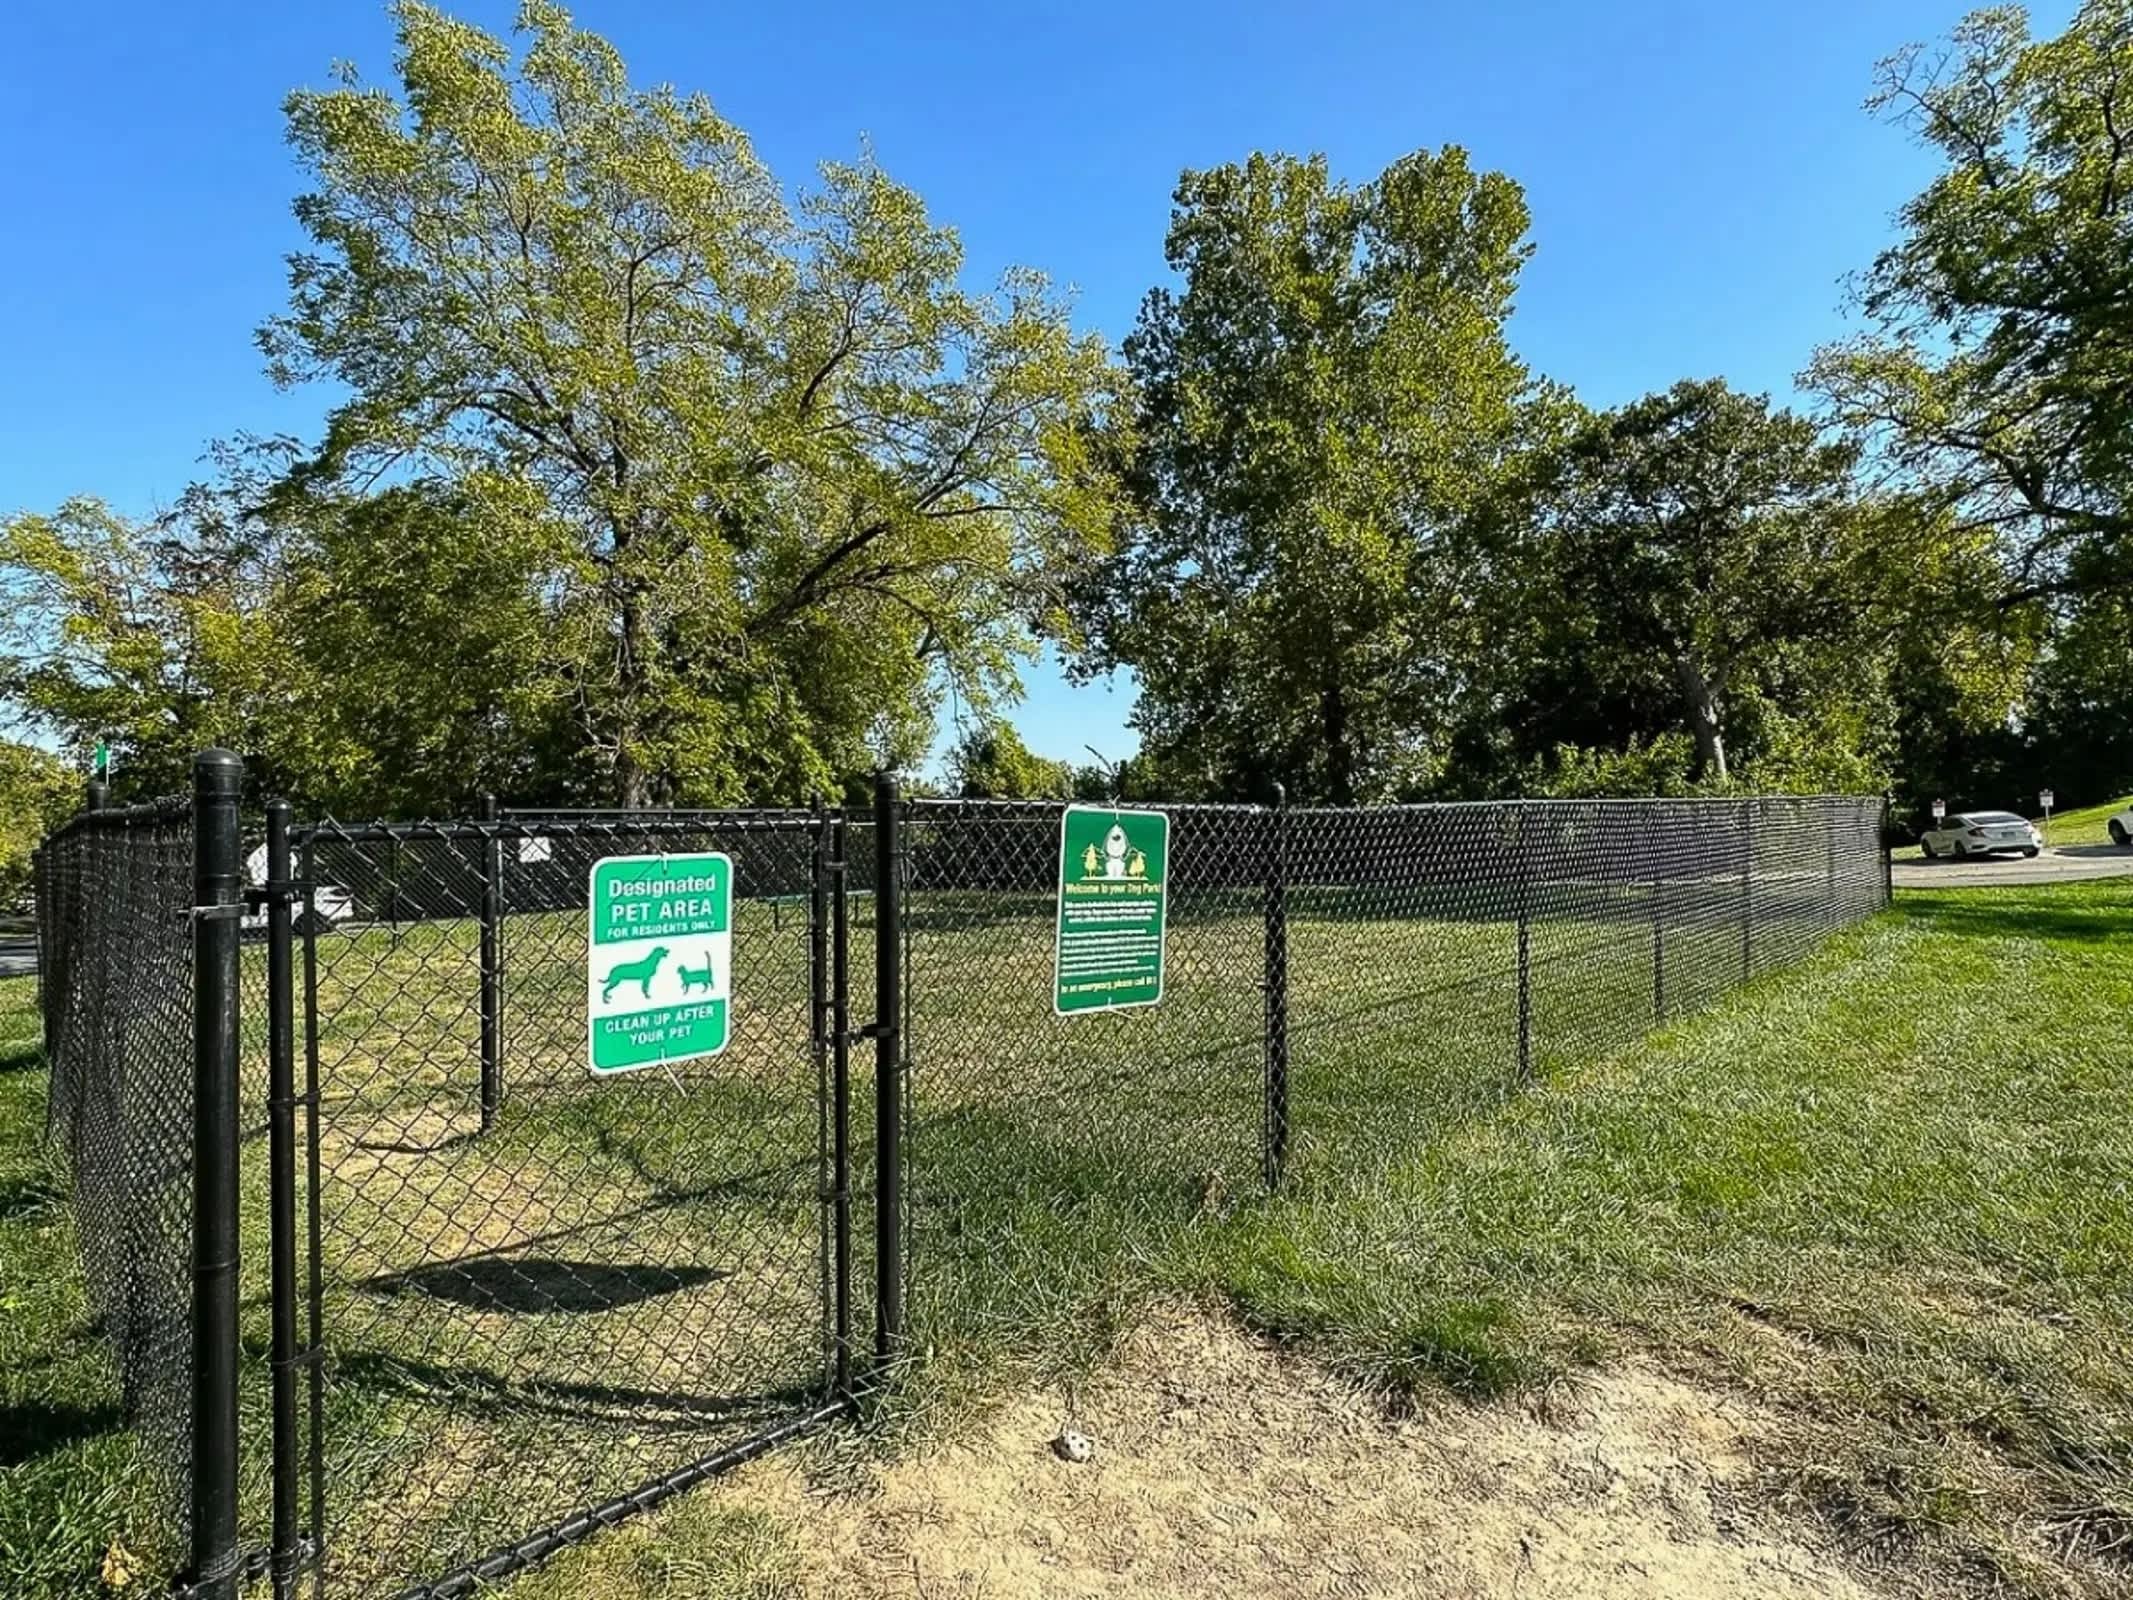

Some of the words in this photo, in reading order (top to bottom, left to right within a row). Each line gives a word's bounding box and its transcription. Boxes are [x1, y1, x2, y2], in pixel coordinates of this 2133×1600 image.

[609, 873, 716, 898] Designated
[611, 902, 651, 923] PET
[660, 898, 712, 919] AREA
[607, 927, 628, 938] FOR
[631, 922, 688, 937] RESIDENTS
[691, 920, 715, 930] ONLY
[605, 1014, 649, 1033] CLEAN
[653, 1012, 671, 1025] UP
[675, 1005, 714, 1022] AFTER
[630, 1028, 664, 1046] YOUR
[669, 1024, 692, 1039] PET
